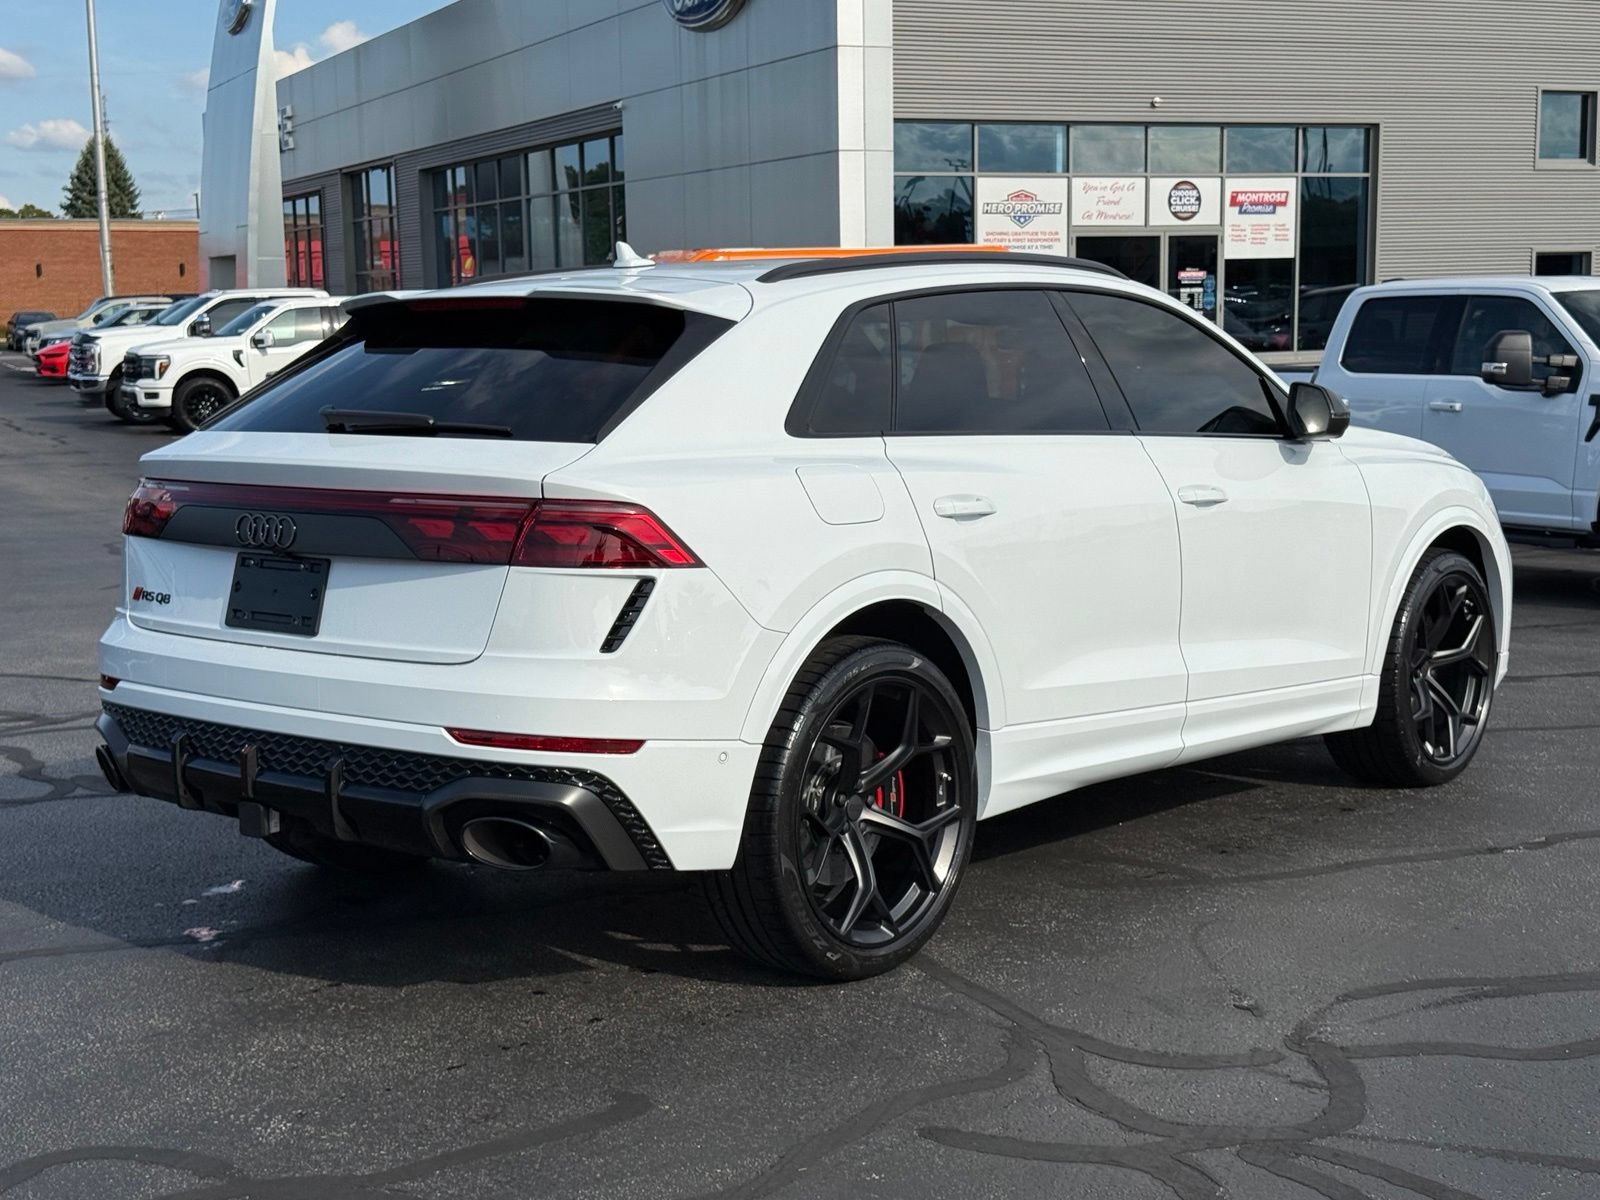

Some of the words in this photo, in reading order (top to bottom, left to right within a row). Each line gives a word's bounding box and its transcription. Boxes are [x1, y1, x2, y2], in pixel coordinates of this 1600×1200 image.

[1236, 192, 1287, 202] MONTROSE
[983, 202, 1013, 214] HERO
[1013, 202, 1062, 214] PROMISE
[1241, 202, 1275, 213] Promise
[142, 590, 155, 602] RS
[155, 592, 171, 605] Q8
